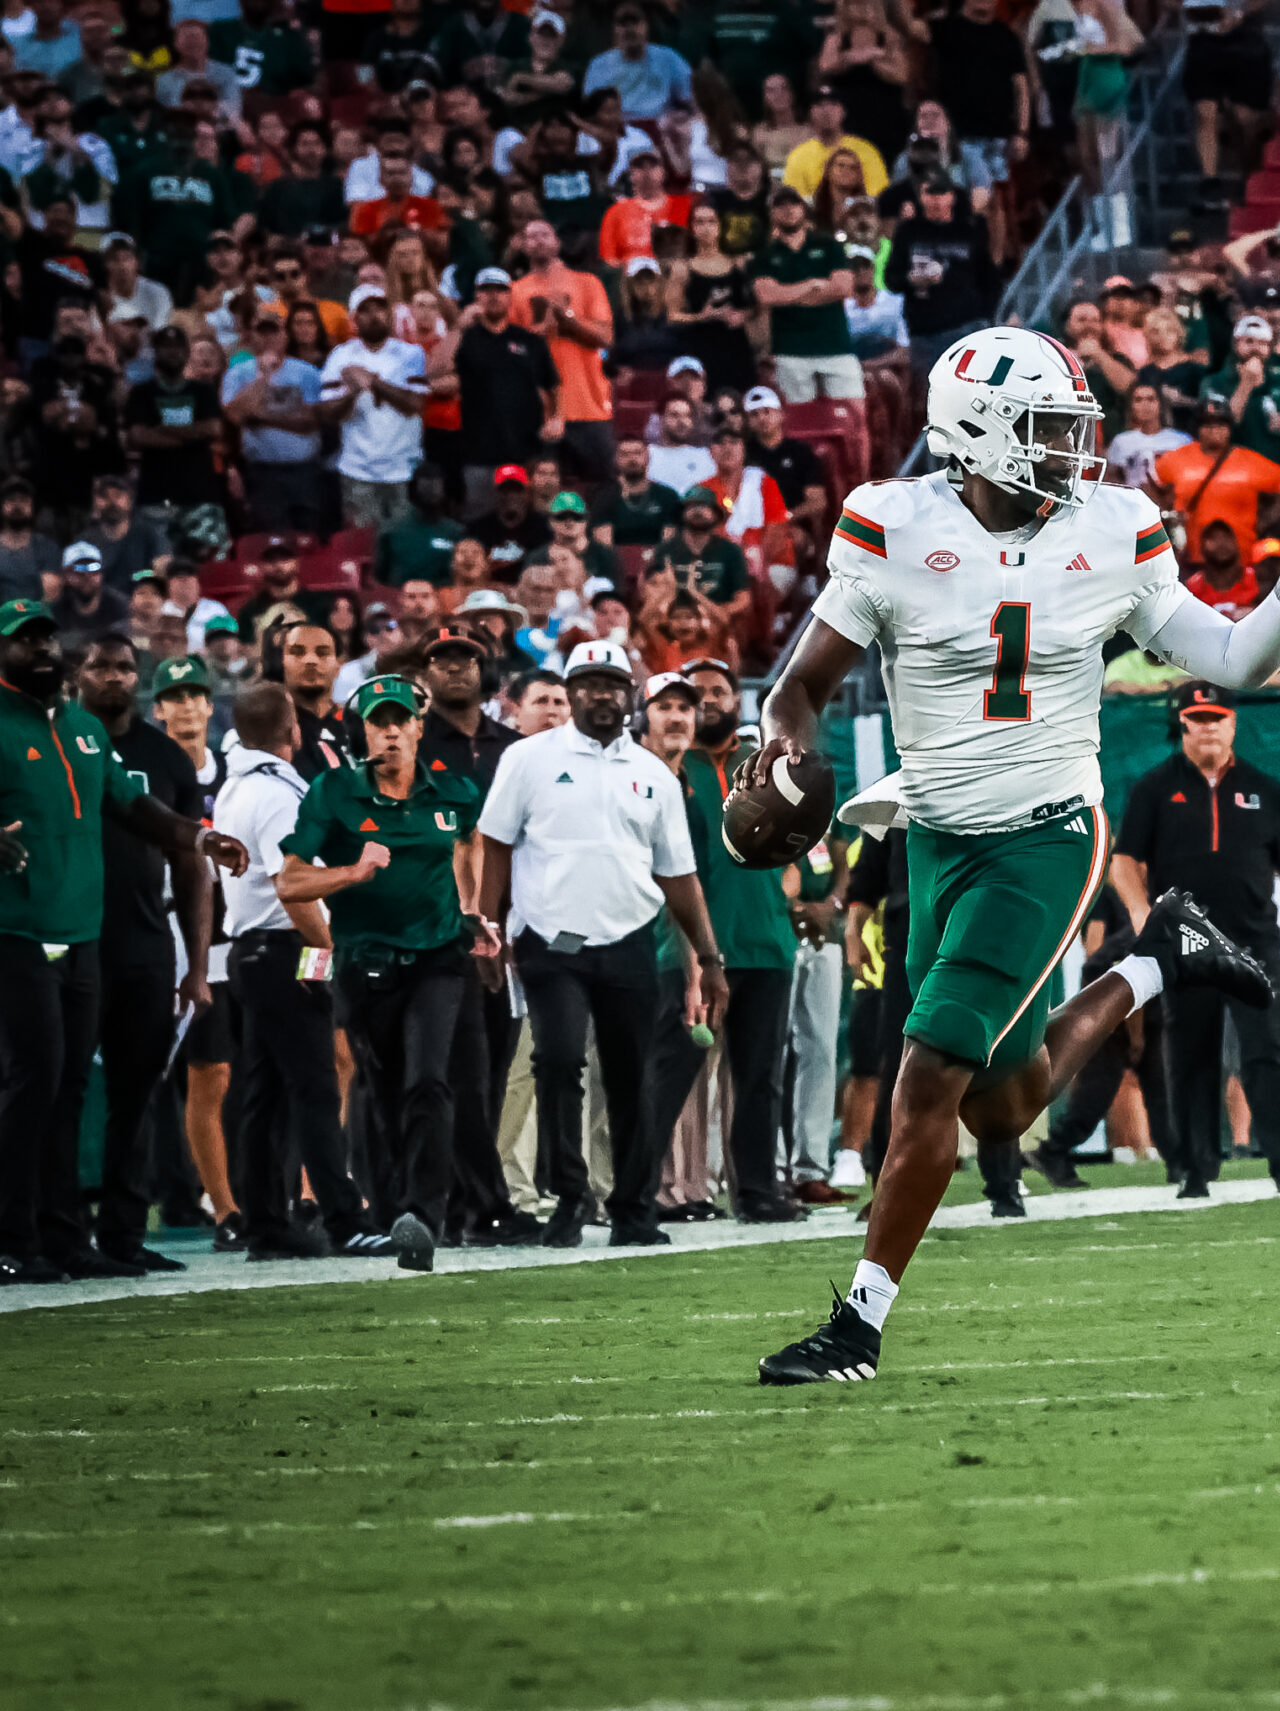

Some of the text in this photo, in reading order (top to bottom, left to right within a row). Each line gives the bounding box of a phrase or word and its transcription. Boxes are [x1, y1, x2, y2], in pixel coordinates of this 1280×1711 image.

[235, 46, 265, 88] 5
[932, 556, 954, 565] ACC
[1000, 551, 1025, 567] U
[983, 601, 1031, 721] 1
